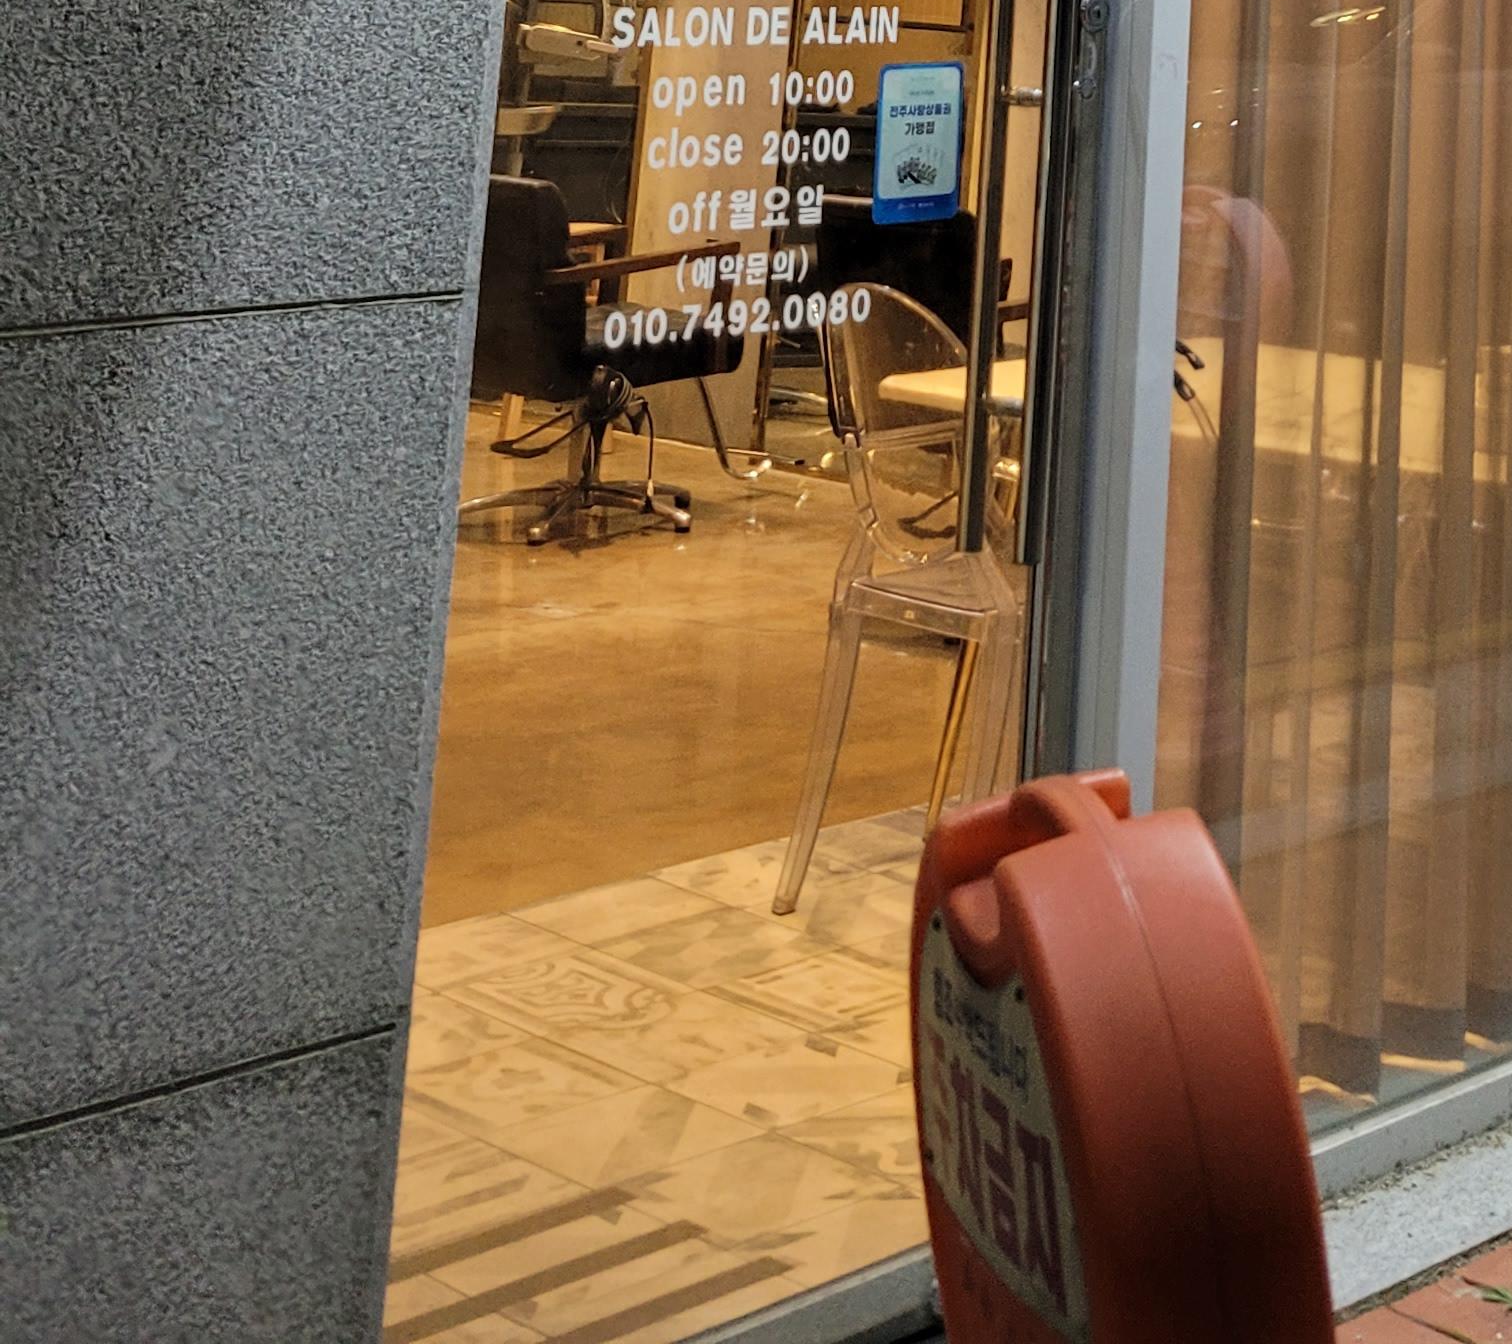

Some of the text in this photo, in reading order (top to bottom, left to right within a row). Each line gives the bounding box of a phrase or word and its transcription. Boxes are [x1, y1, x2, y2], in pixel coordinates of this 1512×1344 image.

[610, 5, 900, 50] SALON DE ALAIN
[652, 69, 855, 116] open 10:00
[647, 126, 852, 170] close 20:00
[602, 287, 872, 349] 010.7492.0080
